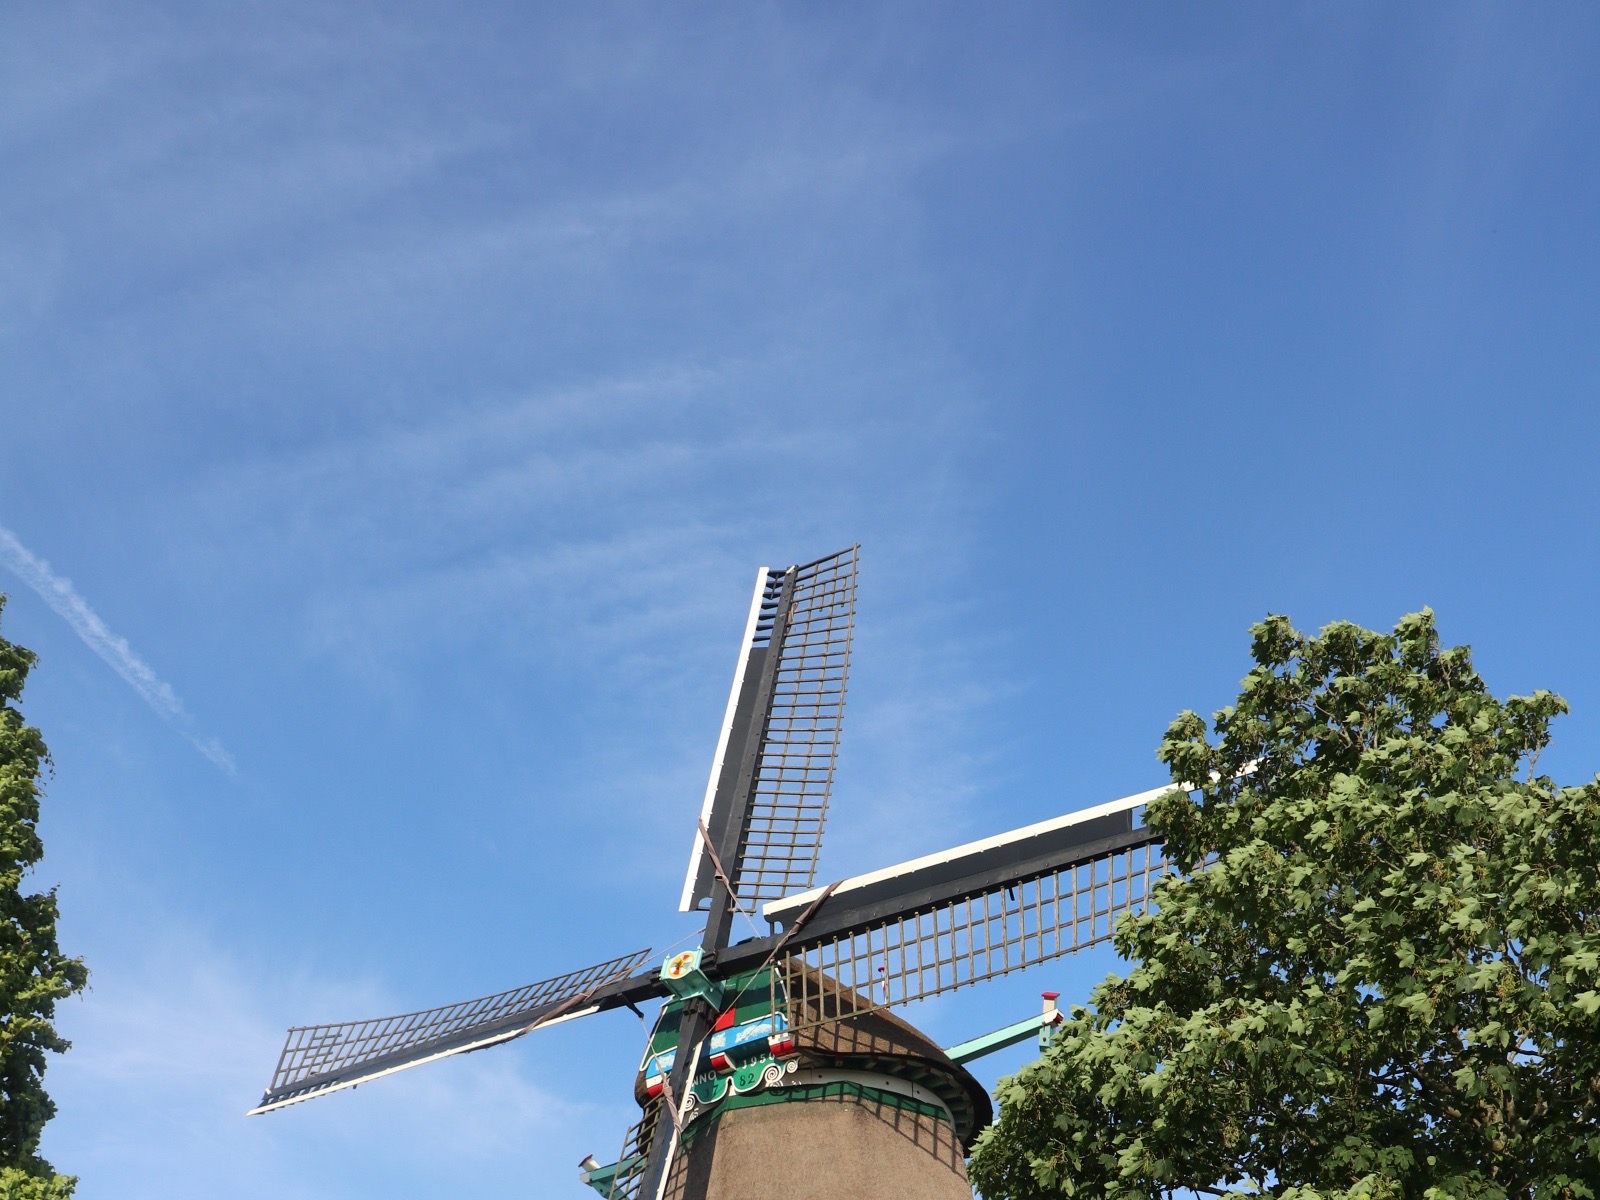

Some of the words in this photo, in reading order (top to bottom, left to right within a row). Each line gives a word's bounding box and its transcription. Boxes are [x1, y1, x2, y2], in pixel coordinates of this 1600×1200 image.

[692, 1070, 716, 1087] NNO
[742, 1052, 775, 1069] 1950
[705, 1084, 719, 1098] 17
[739, 1073, 755, 1087] 82
